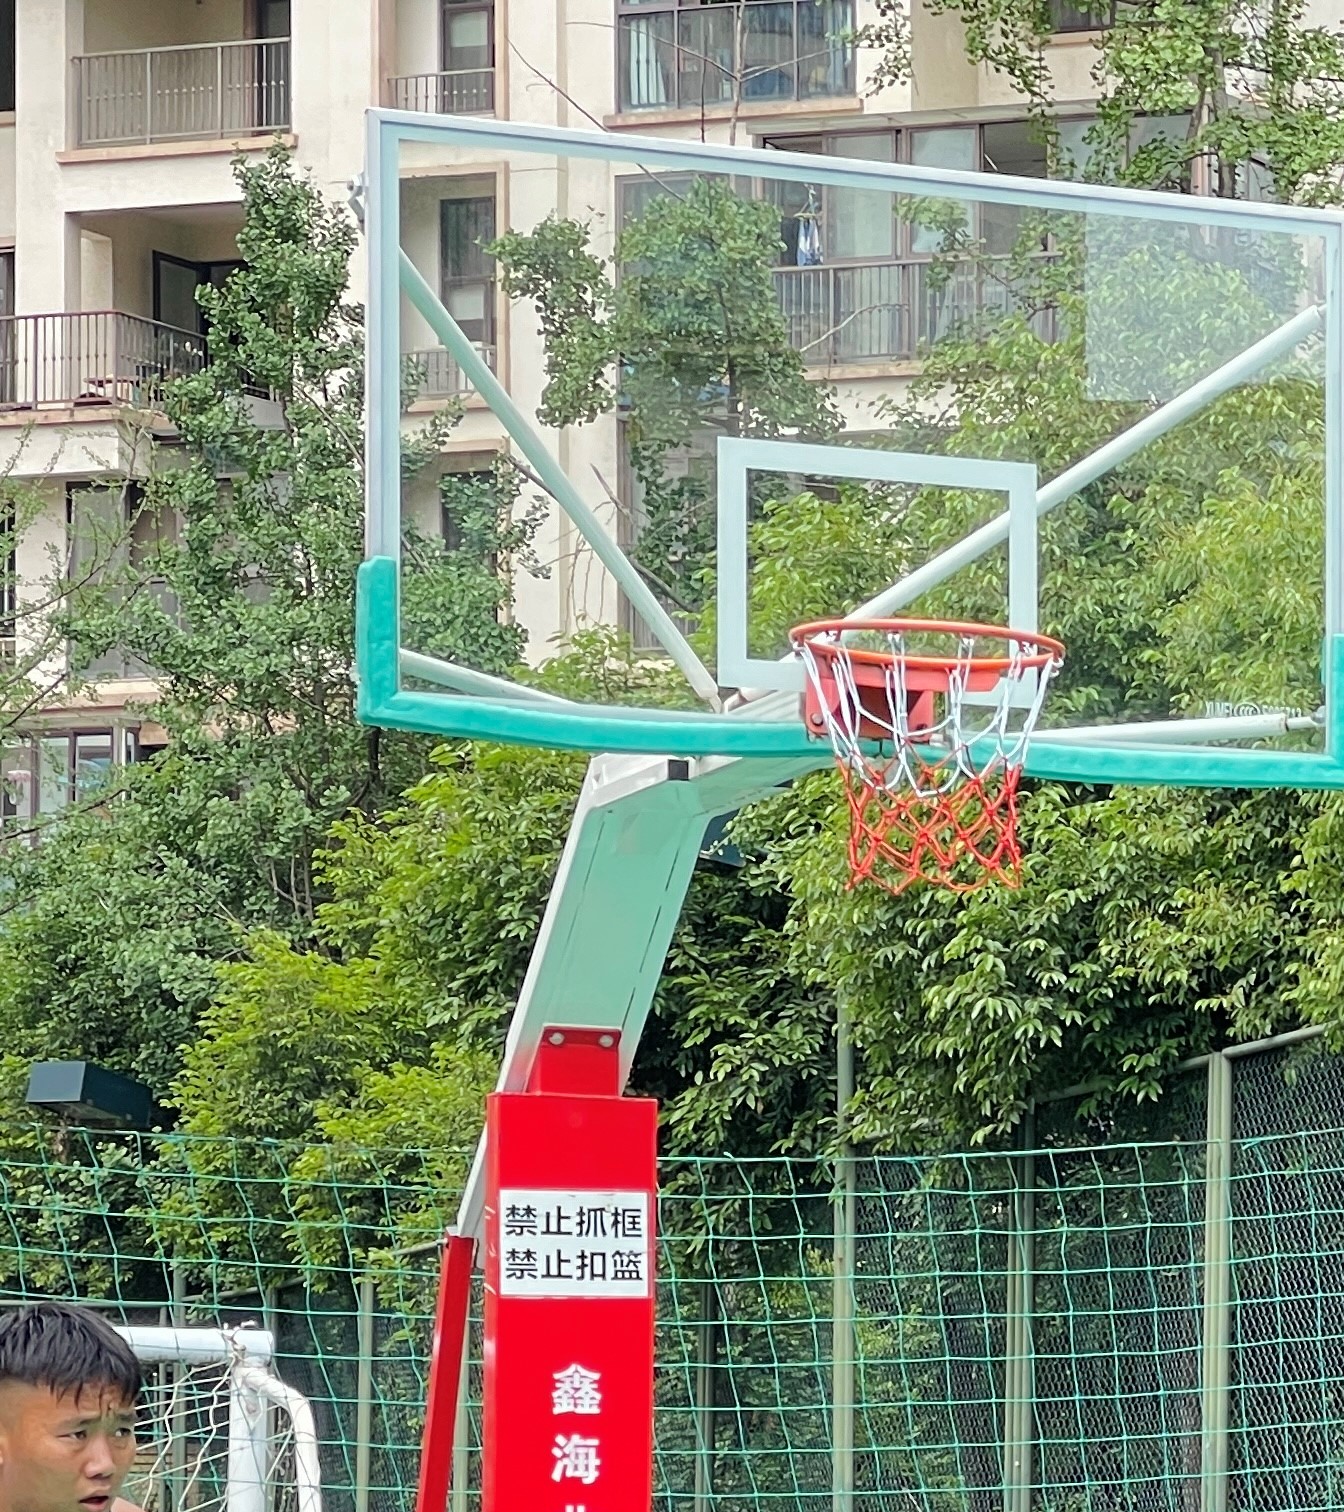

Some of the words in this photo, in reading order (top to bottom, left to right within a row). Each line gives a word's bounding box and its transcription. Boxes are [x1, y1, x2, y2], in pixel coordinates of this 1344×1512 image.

[505, 1204, 643, 1239] 禁止抓框
[505, 1249, 643, 1282] 禁止扣篮
